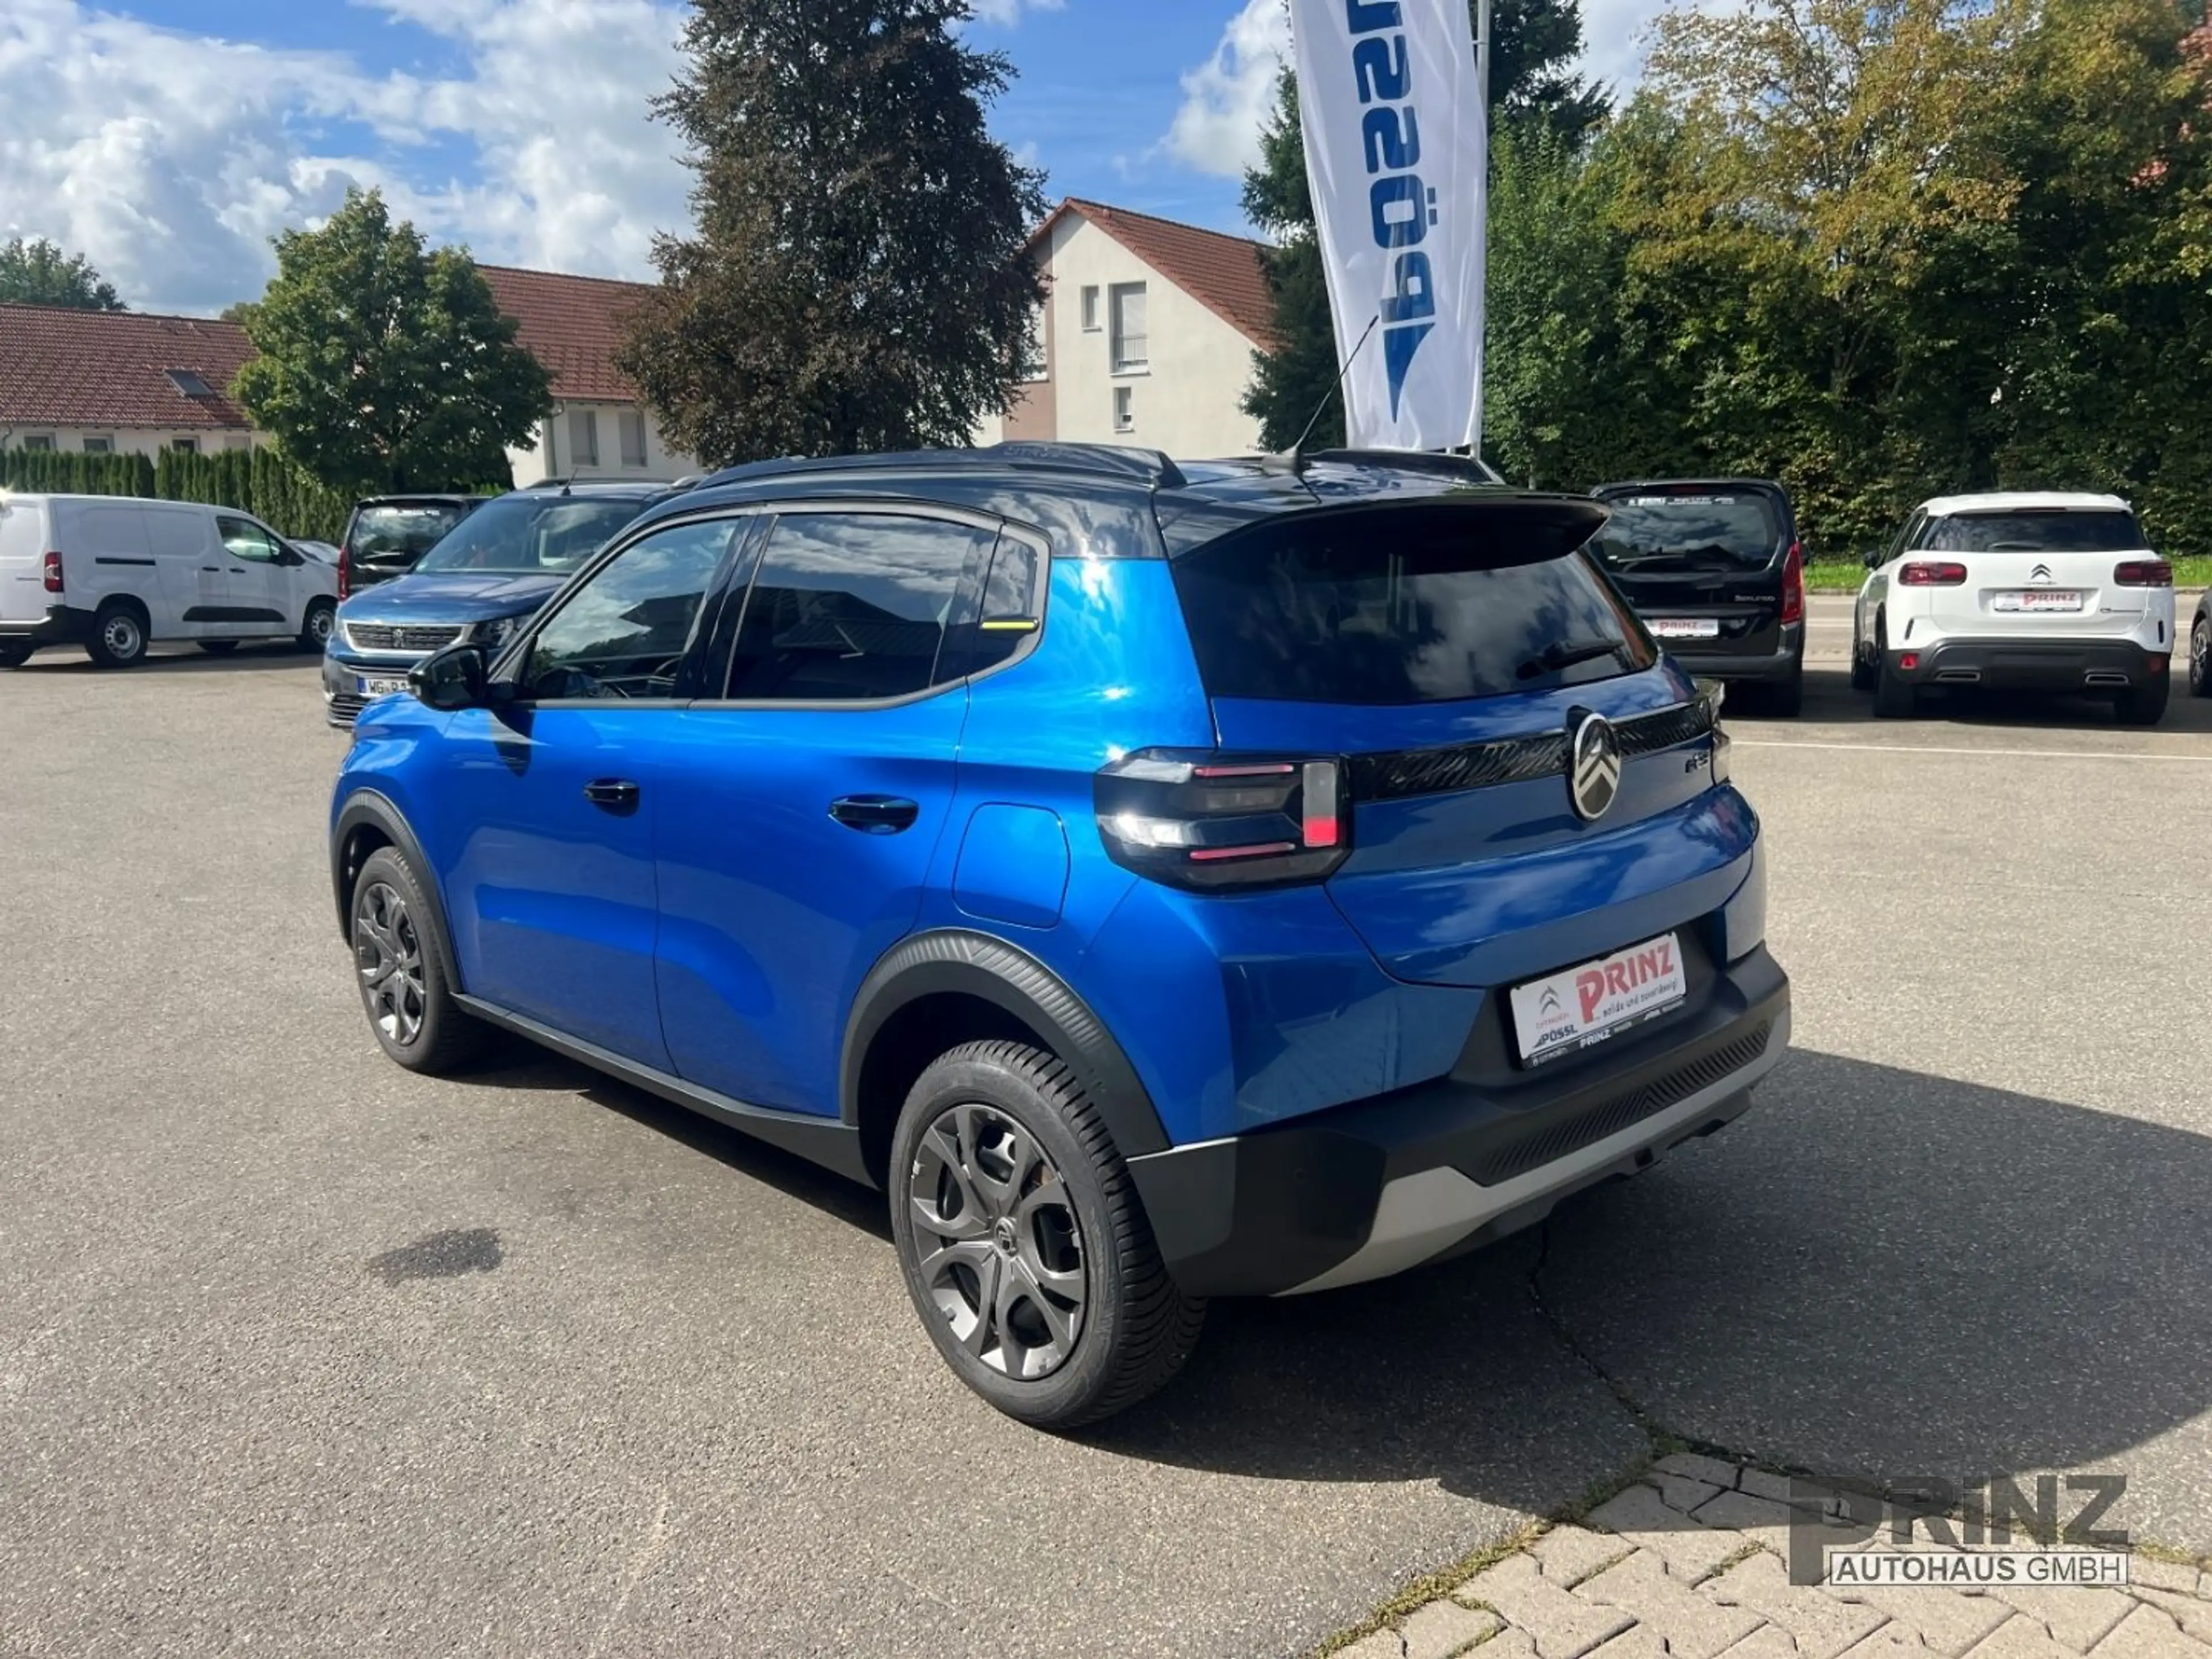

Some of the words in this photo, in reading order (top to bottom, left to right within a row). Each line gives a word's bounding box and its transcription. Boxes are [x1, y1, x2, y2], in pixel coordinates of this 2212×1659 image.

[2023, 593, 2076, 605] PRINZ
[1659, 621, 1698, 631] PRINZ
[1576, 942, 1674, 1024] PRINZ
